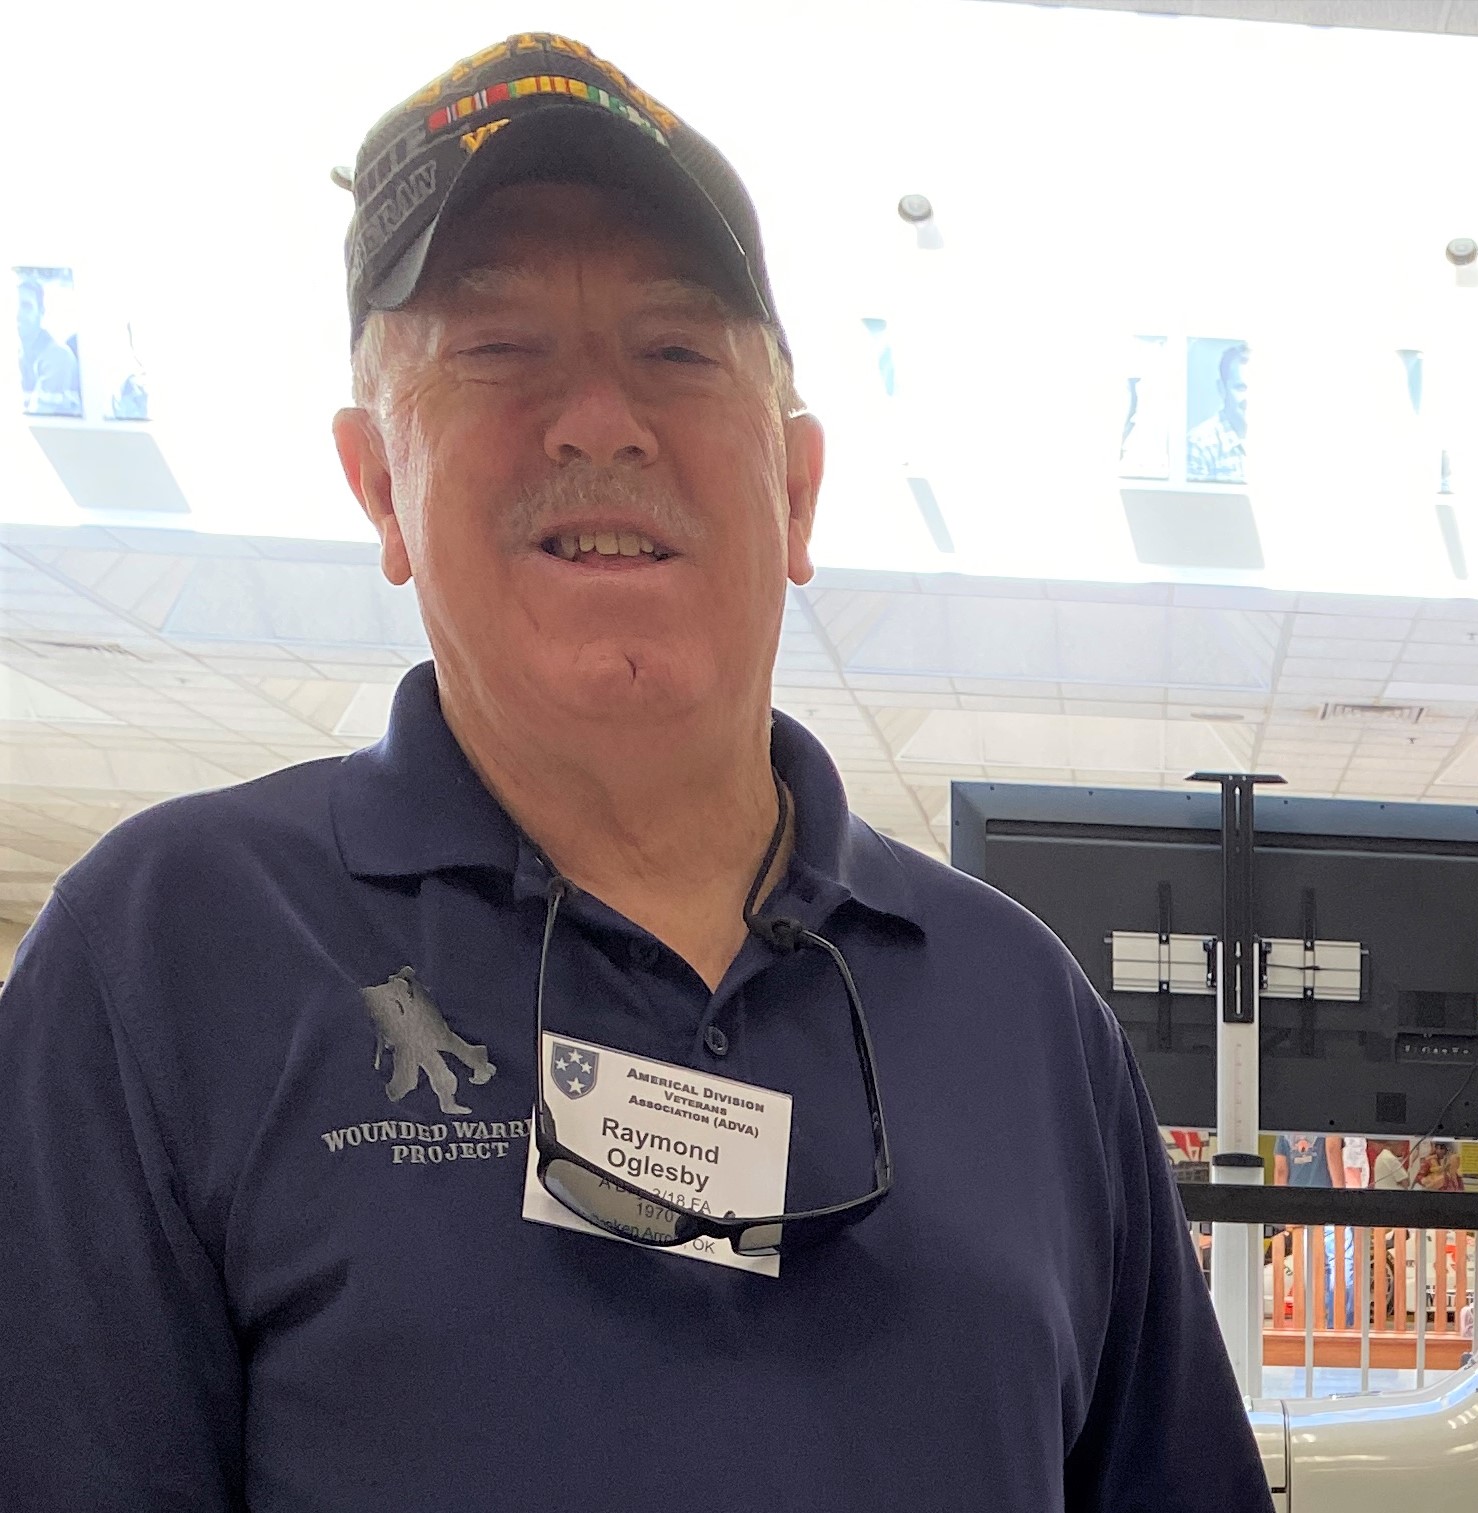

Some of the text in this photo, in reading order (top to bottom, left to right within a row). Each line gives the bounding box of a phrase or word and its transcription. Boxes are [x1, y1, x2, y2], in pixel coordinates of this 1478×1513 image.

[321, 1119, 448, 1153] WOUNDED
[713, 1116, 759, 1139] (ADVA)
[391, 1140, 510, 1164] PROJECT
[601, 1116, 719, 1165] Raymond
[607, 1147, 710, 1193] Oglesby
[636, 1202, 674, 1223] 1970
[691, 1197, 712, 1215] FA
[692, 1238, 716, 1255] OK
